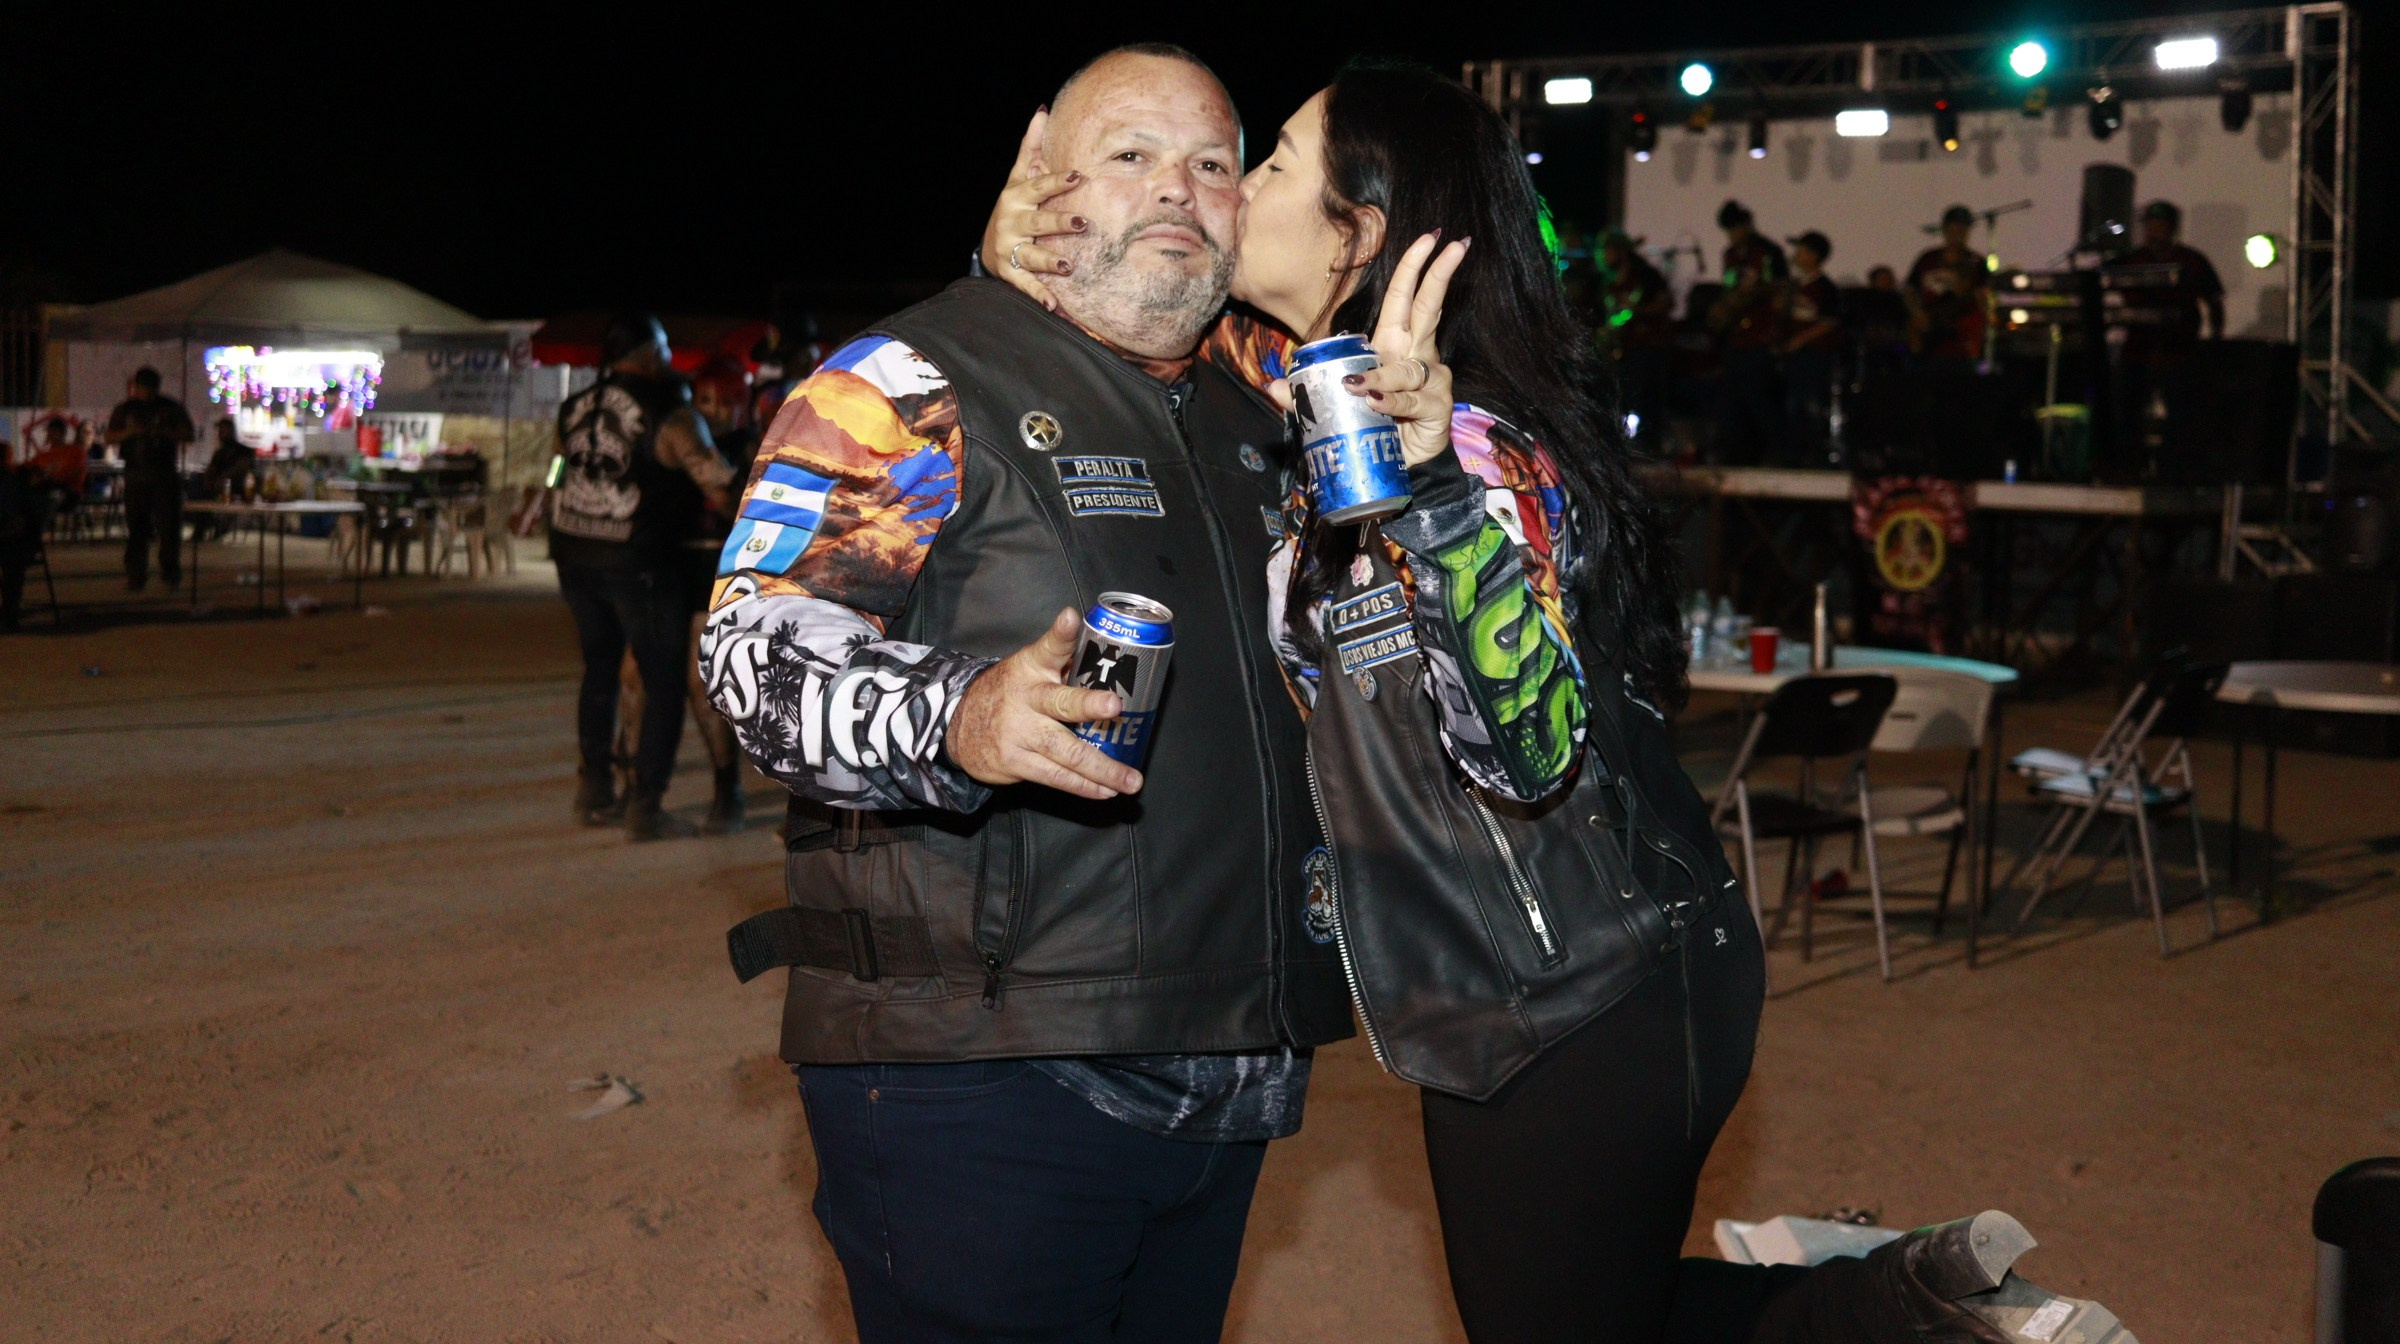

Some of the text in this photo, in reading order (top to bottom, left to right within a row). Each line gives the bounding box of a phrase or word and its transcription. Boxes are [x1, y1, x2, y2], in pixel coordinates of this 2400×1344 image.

[1074, 460, 1133, 479] PERALTA
[1073, 494, 1157, 510] PRESIDENTE
[1361, 593, 1394, 617] POS
[1098, 617, 1141, 639] 355mL
[1395, 630, 1416, 650] MC
[1096, 658, 1117, 683] T
